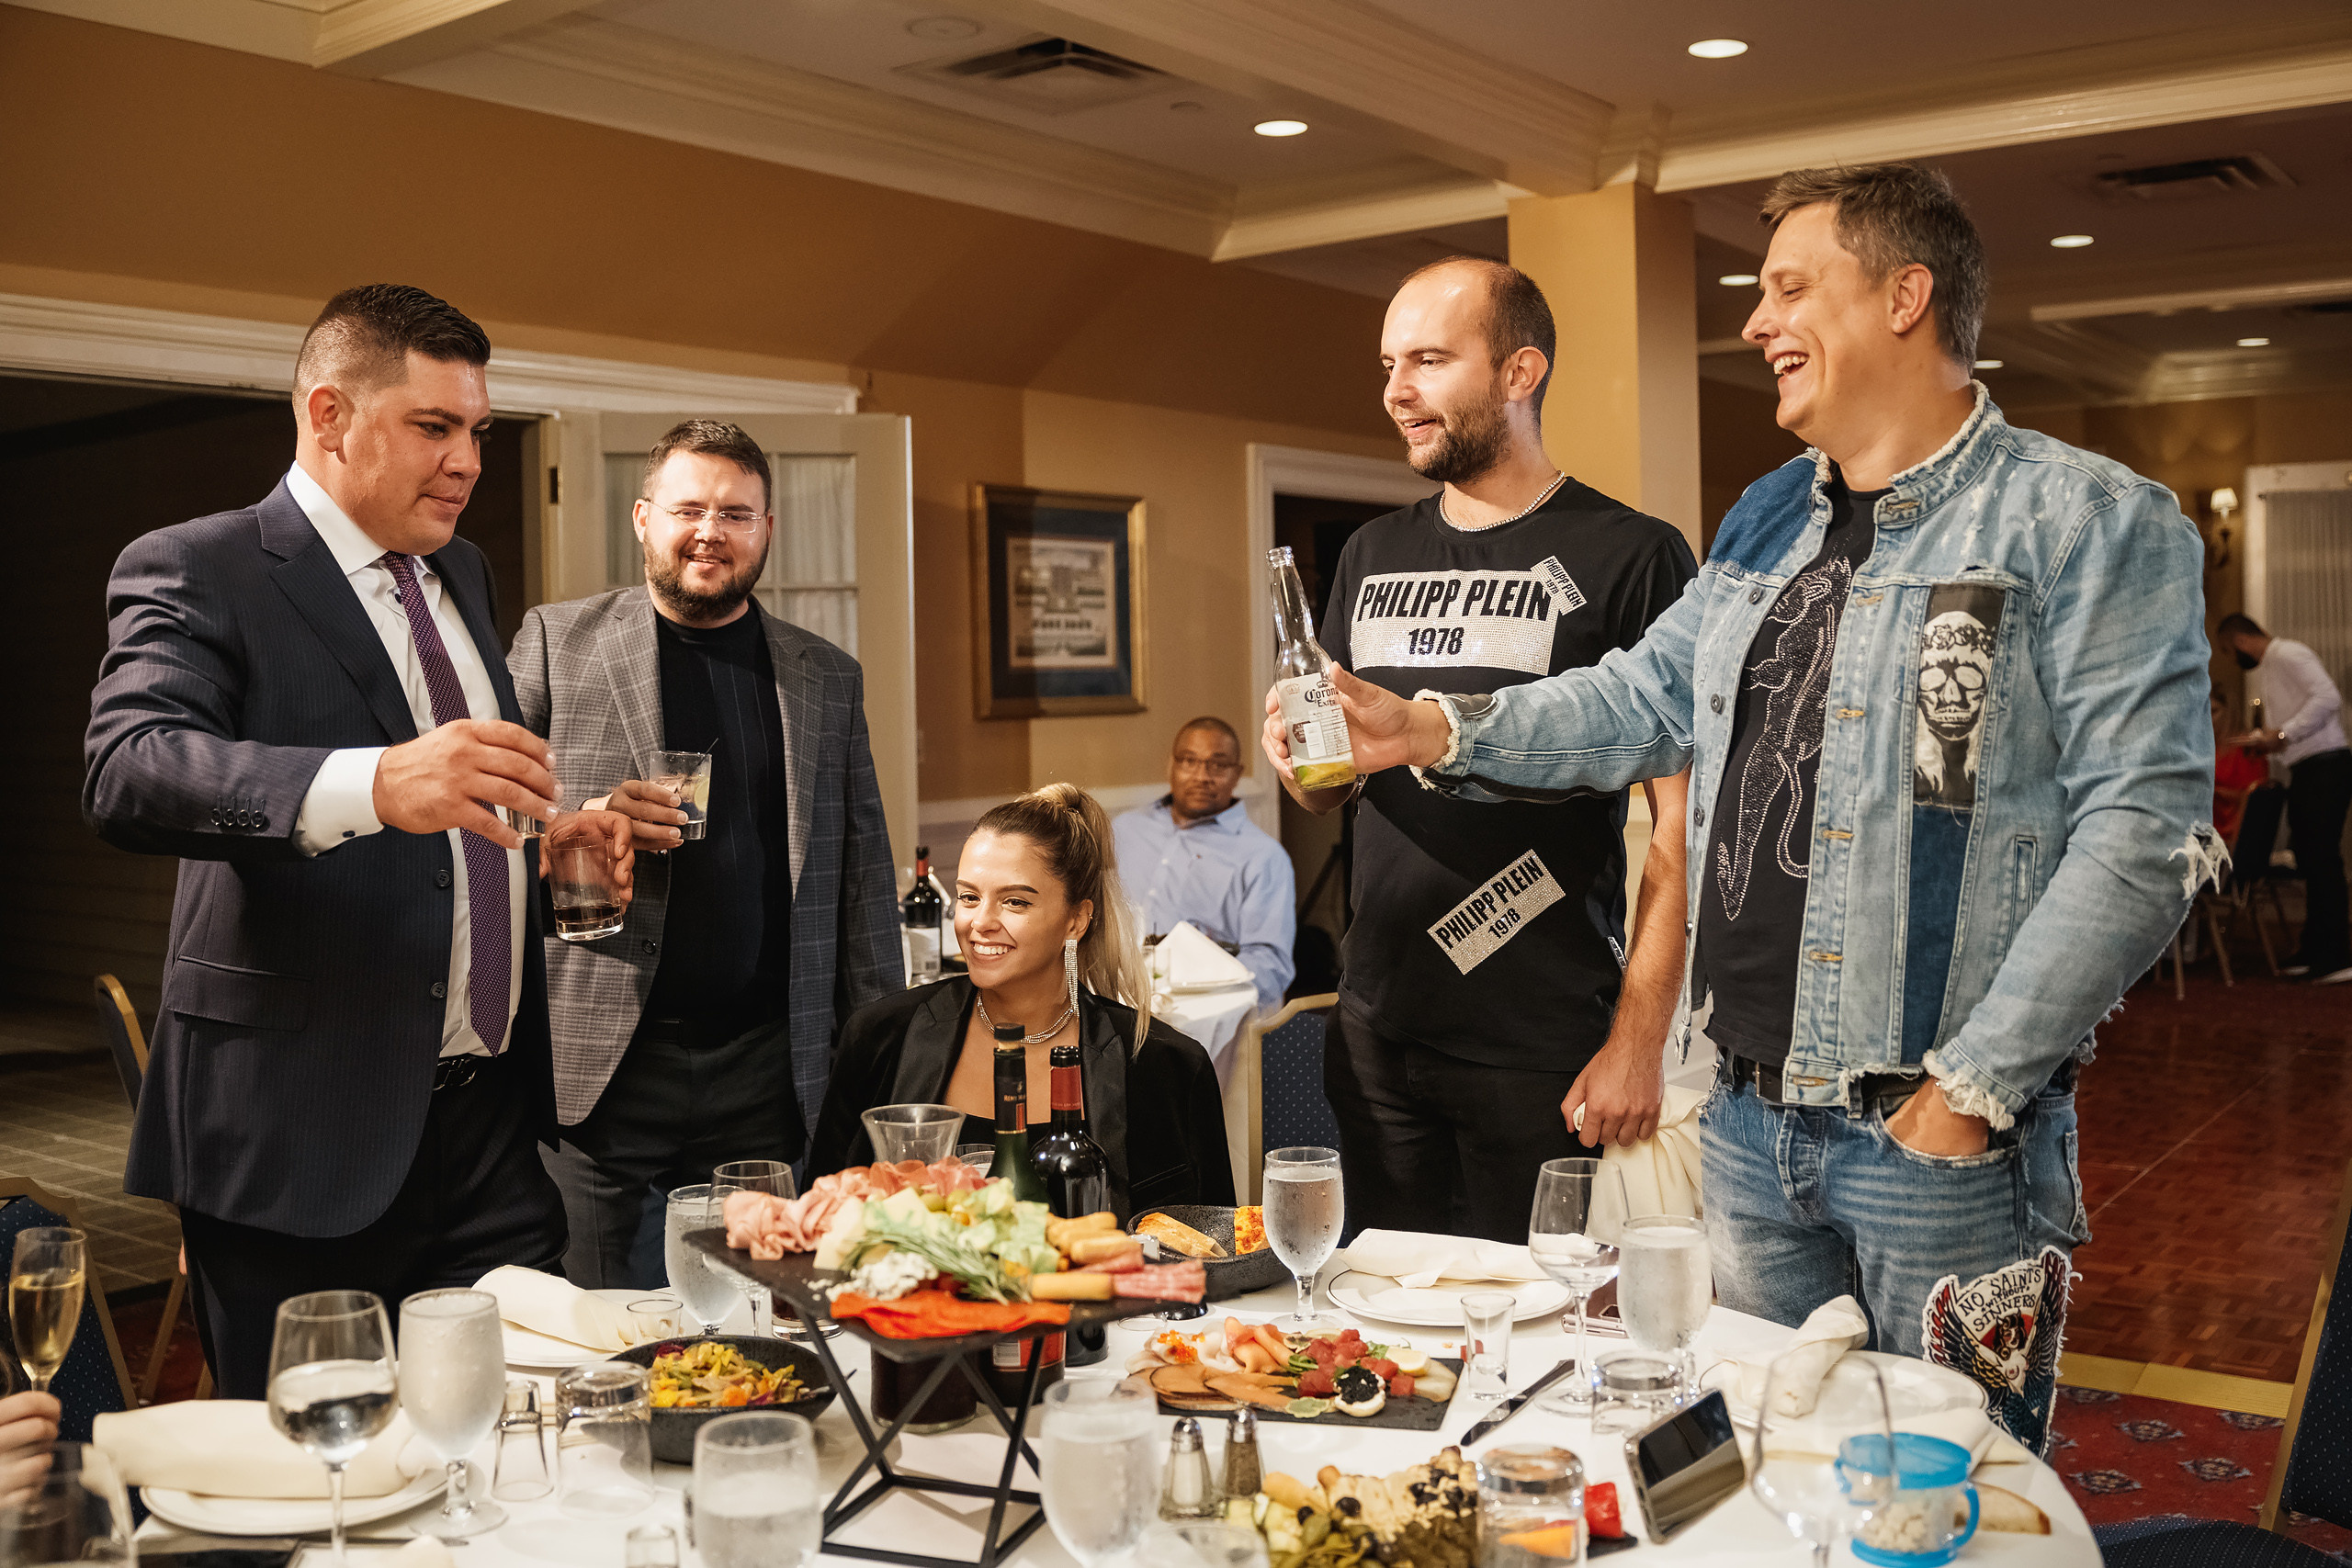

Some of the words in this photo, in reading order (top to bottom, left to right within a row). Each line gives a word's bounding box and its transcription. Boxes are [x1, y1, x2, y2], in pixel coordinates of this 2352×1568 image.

[1357, 579, 1461, 622] PHILIPP
[1462, 580, 1552, 622] PLEIN
[1544, 558, 1569, 584] PHILIPP
[1562, 583, 1583, 607] PLEIN
[1408, 626, 1464, 655] 1978
[1434, 891, 1498, 950] PHILIPP
[1491, 856, 1544, 904] PLEIN
[1488, 908, 1521, 939] 1978
[1959, 1292, 1984, 1316] NO
[1990, 1269, 2041, 1296] SAINTS
[1985, 1286, 2025, 1308] WITHOUT
[1973, 1294, 2036, 1332] SINNERS
